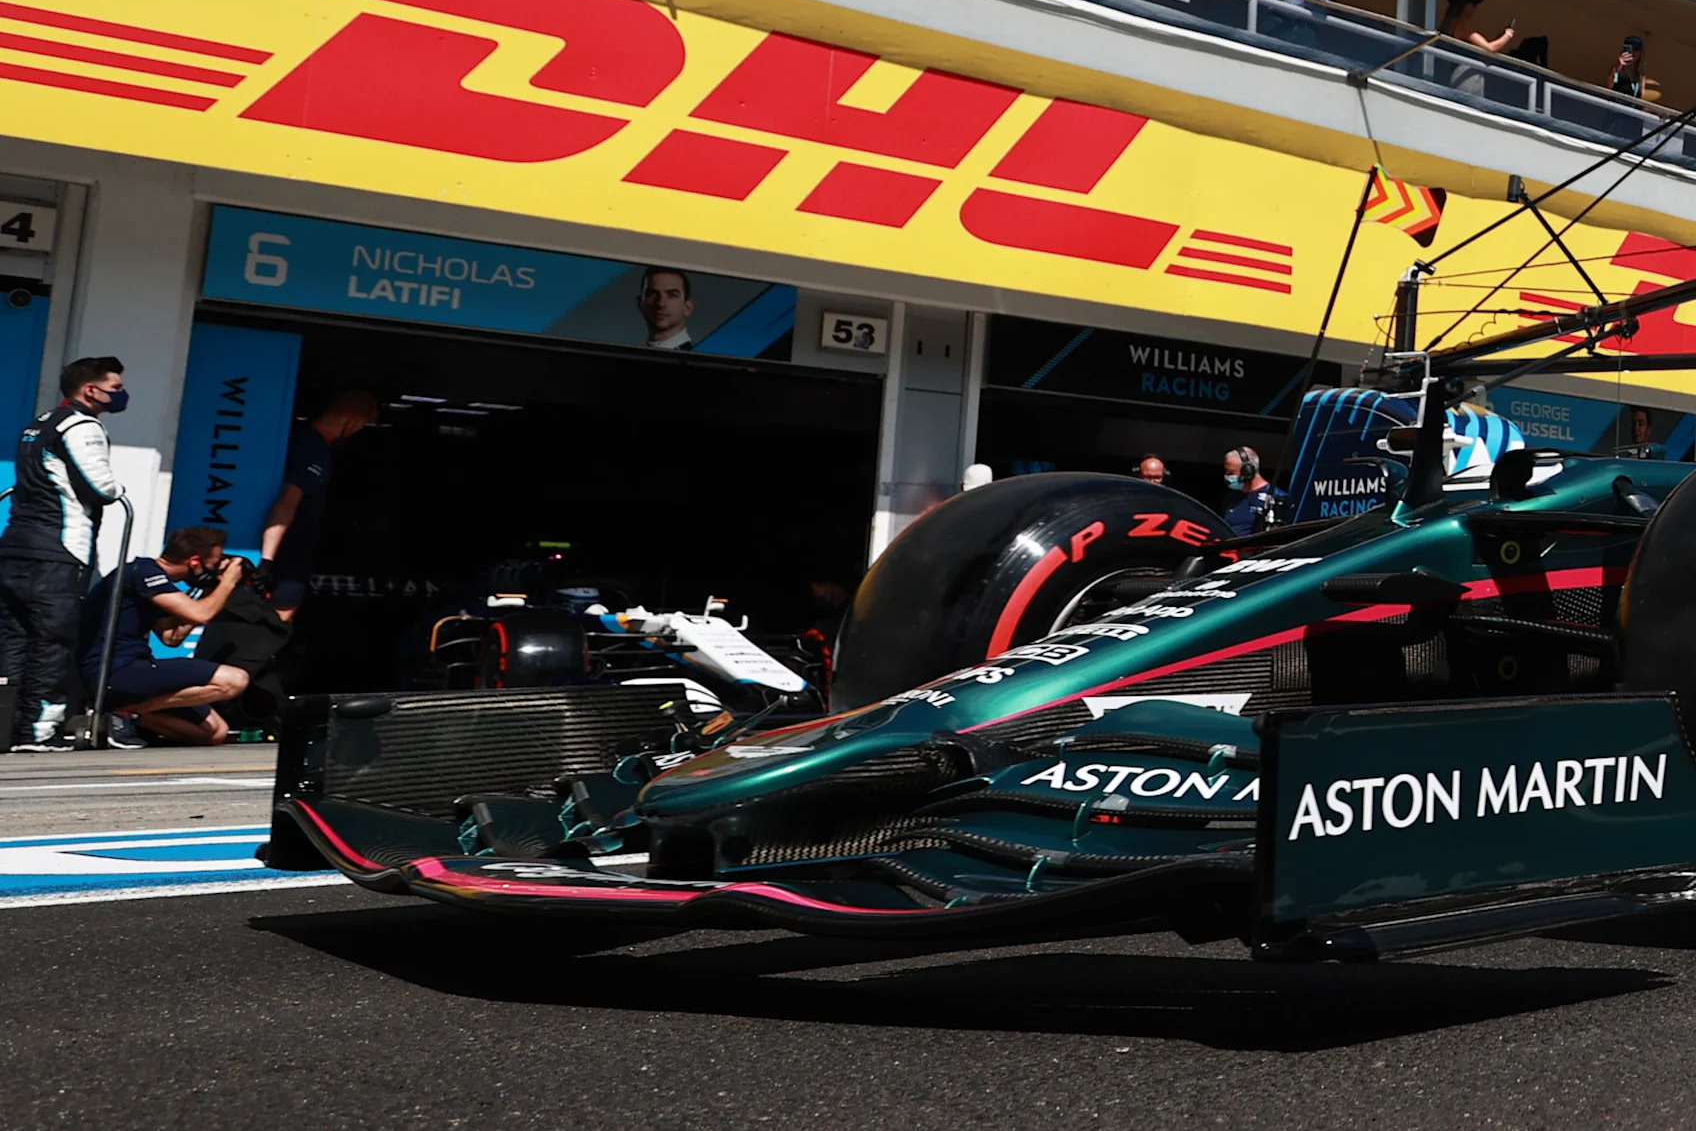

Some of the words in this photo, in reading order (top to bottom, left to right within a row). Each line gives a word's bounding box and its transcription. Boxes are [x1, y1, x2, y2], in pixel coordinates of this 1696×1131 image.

[244, 232, 291, 287] 6
[352, 245, 536, 288] NICHOLAS
[348, 275, 460, 309] LATIFI
[1129, 345, 1245, 378] WILLIAMS
[1141, 373, 1231, 401] RACING
[1510, 401, 1571, 422] GEORGE
[201, 377, 249, 525] WILLIAM
[1314, 476, 1387, 496] WILLIAMS
[1320, 498, 1378, 517] RACING
[1070, 520, 1105, 563] P
[1020, 762, 1230, 801] ASTON
[1288, 770, 1461, 841] ASTON
[1476, 753, 1667, 818] MARTIN
